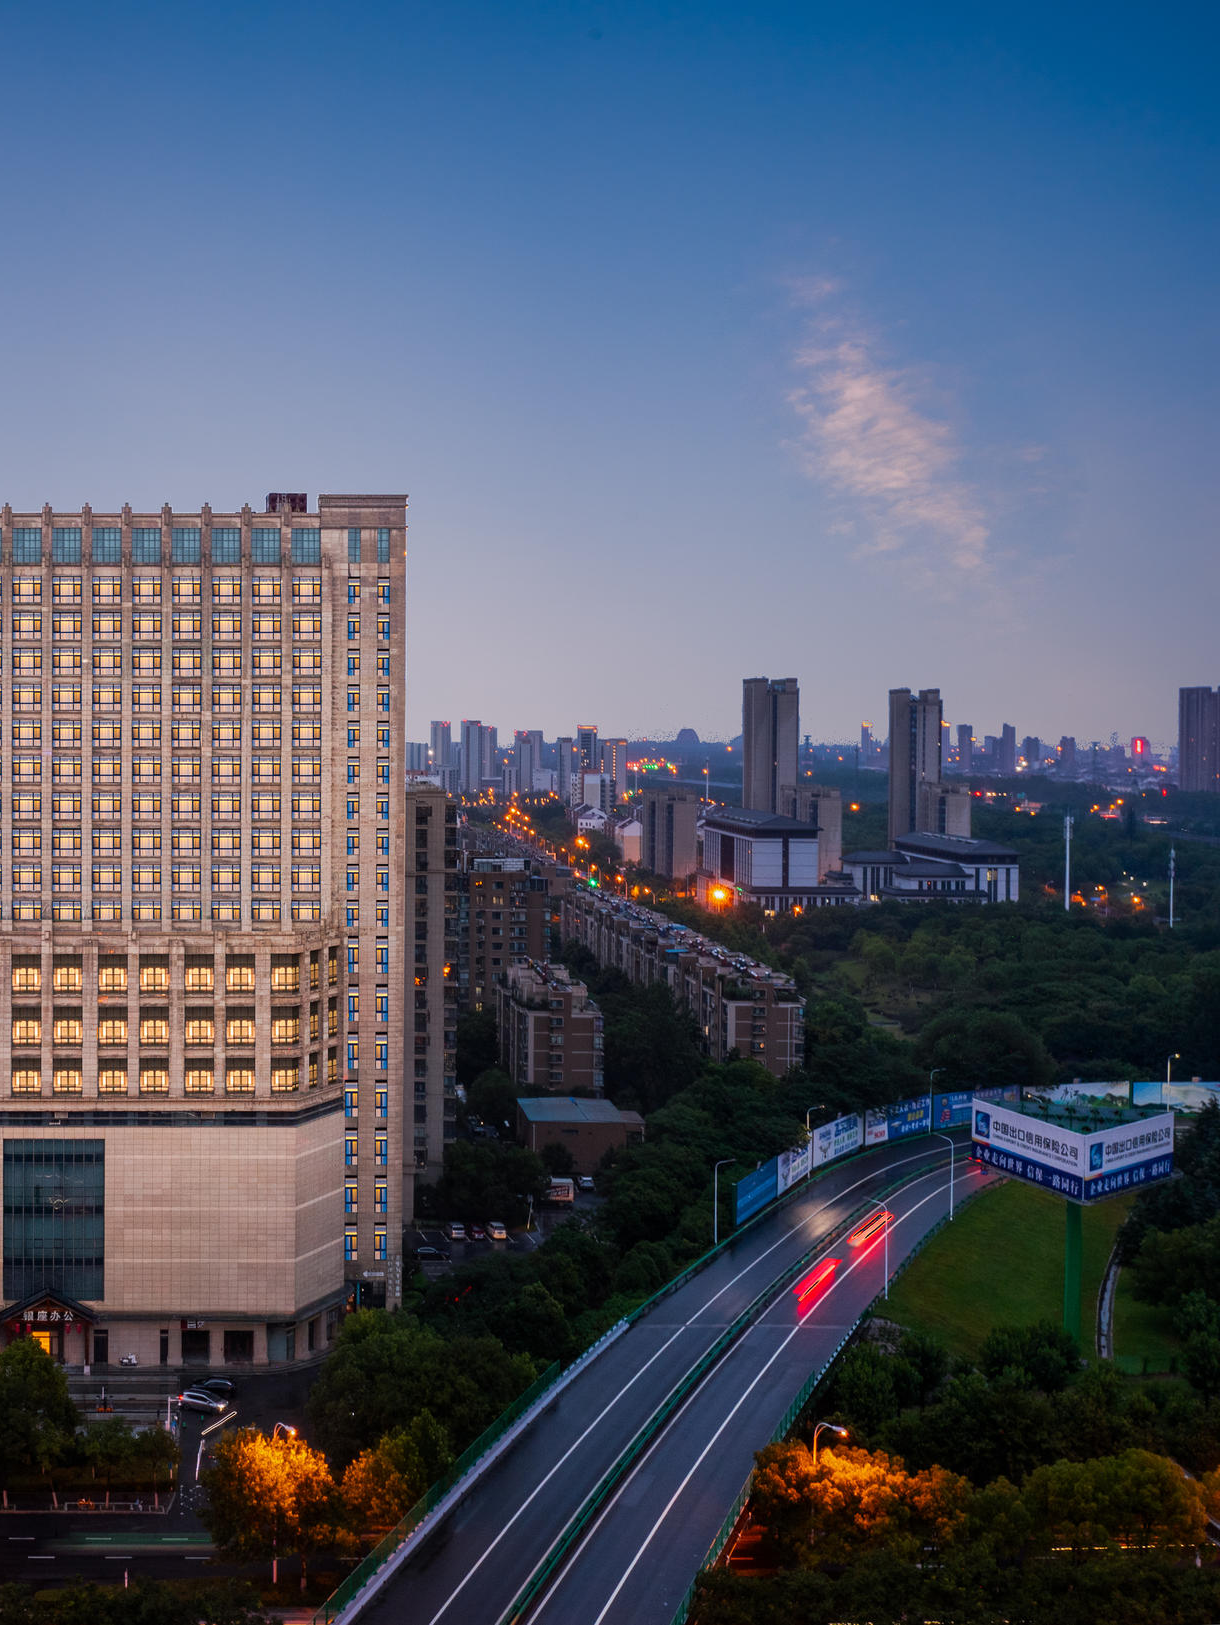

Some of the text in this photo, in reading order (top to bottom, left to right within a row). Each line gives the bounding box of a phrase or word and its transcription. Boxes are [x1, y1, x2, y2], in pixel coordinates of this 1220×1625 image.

[993, 1120, 1079, 1161] 中国出口信用保险公司
[1105, 1127, 1171, 1156] 中国出口信用保险公司
[23, 1310, 74, 1321] 银座办公
